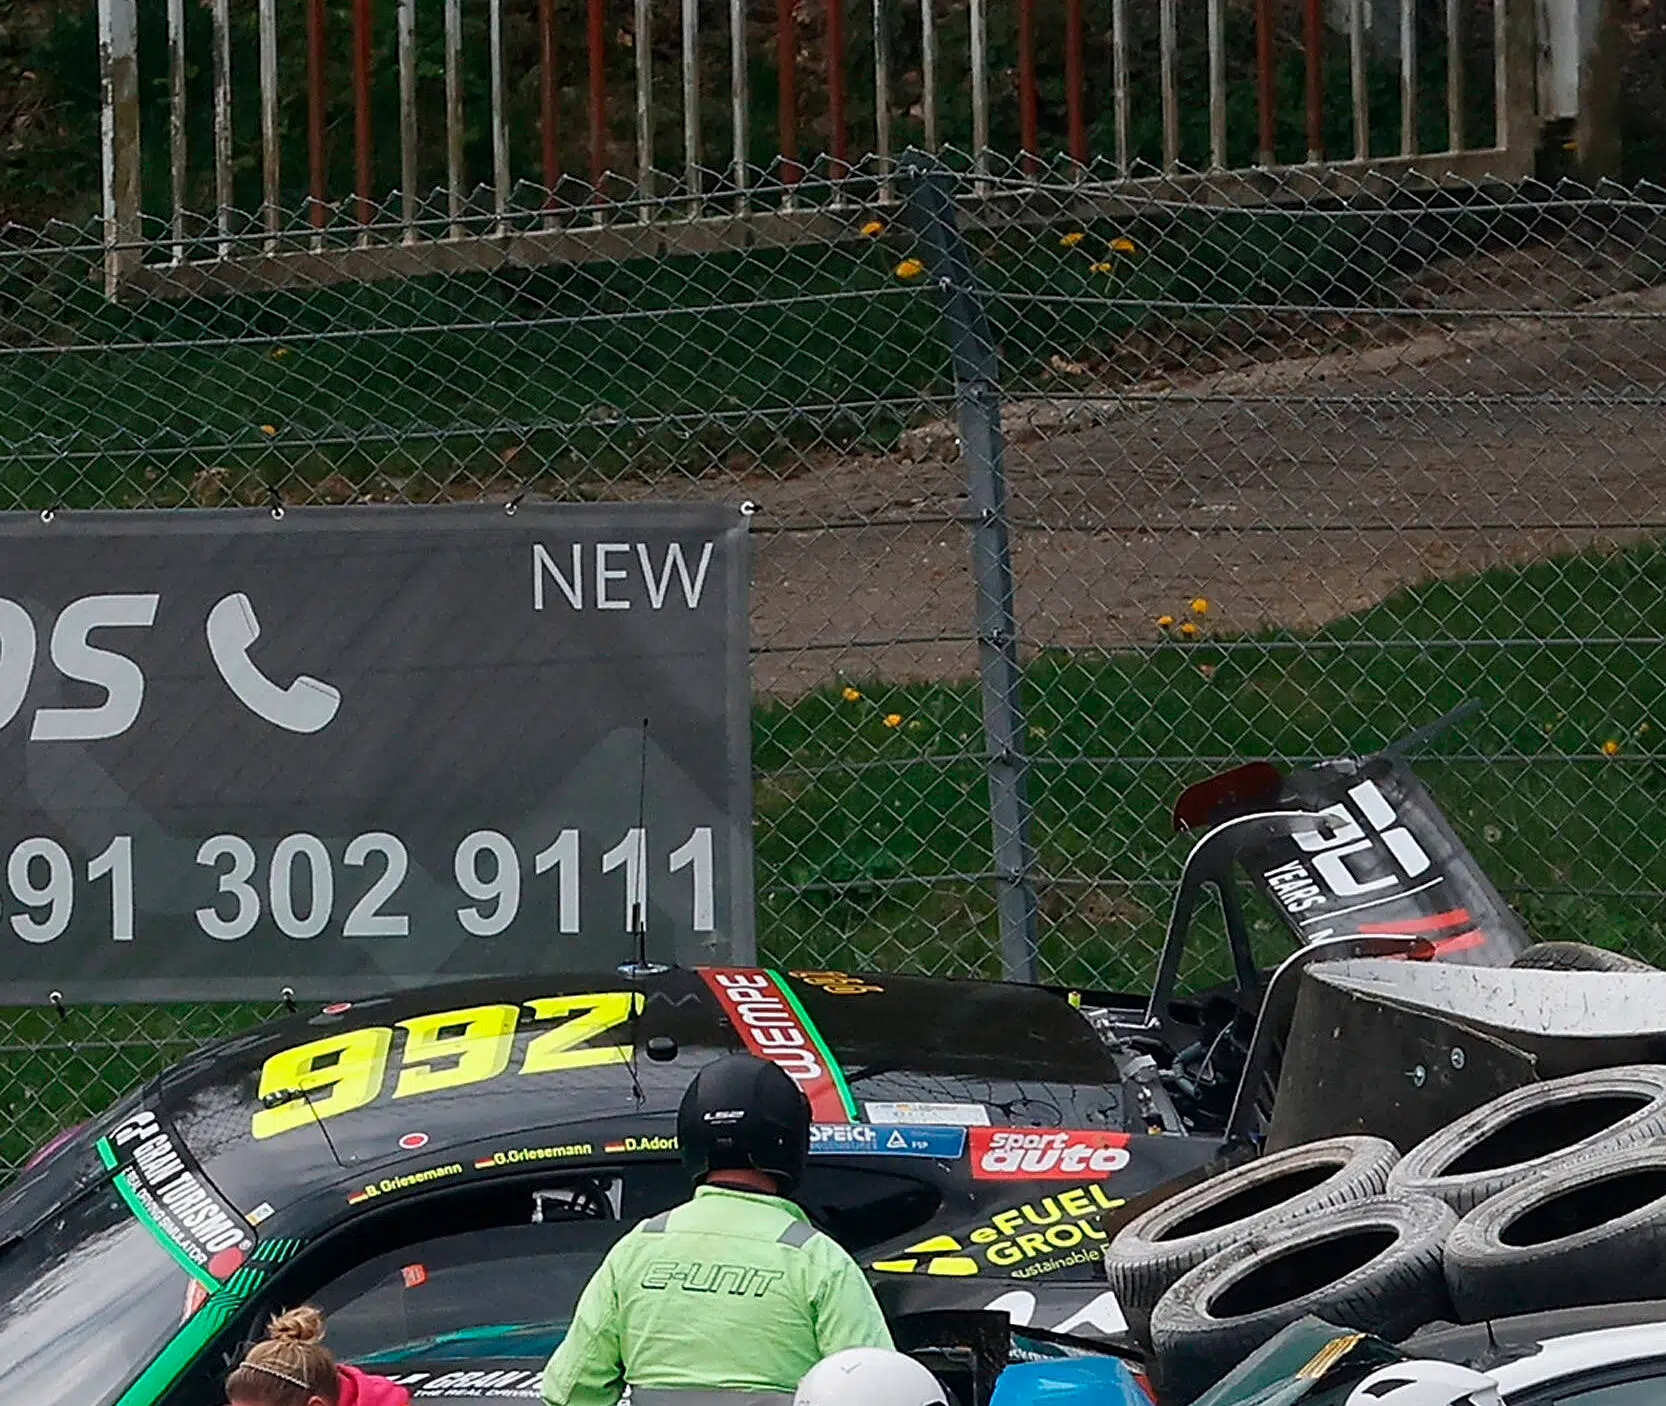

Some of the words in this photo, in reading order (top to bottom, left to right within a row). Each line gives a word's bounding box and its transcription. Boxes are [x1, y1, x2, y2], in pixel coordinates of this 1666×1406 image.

[532, 542, 713, 611] NEW
[0, 835, 133, 942] 91
[195, 831, 409, 941] 302
[454, 827, 715, 937] 9111
[1263, 859, 1327, 913] YEARS
[251, 992, 645, 1140] 992
[132, 1133, 185, 1187] GRAN
[981, 1143, 1131, 1172] auto
[989, 1131, 1069, 1152] sport
[969, 1184, 1126, 1244] eFUEL
[641, 1260, 783, 1297] E-UNIT
